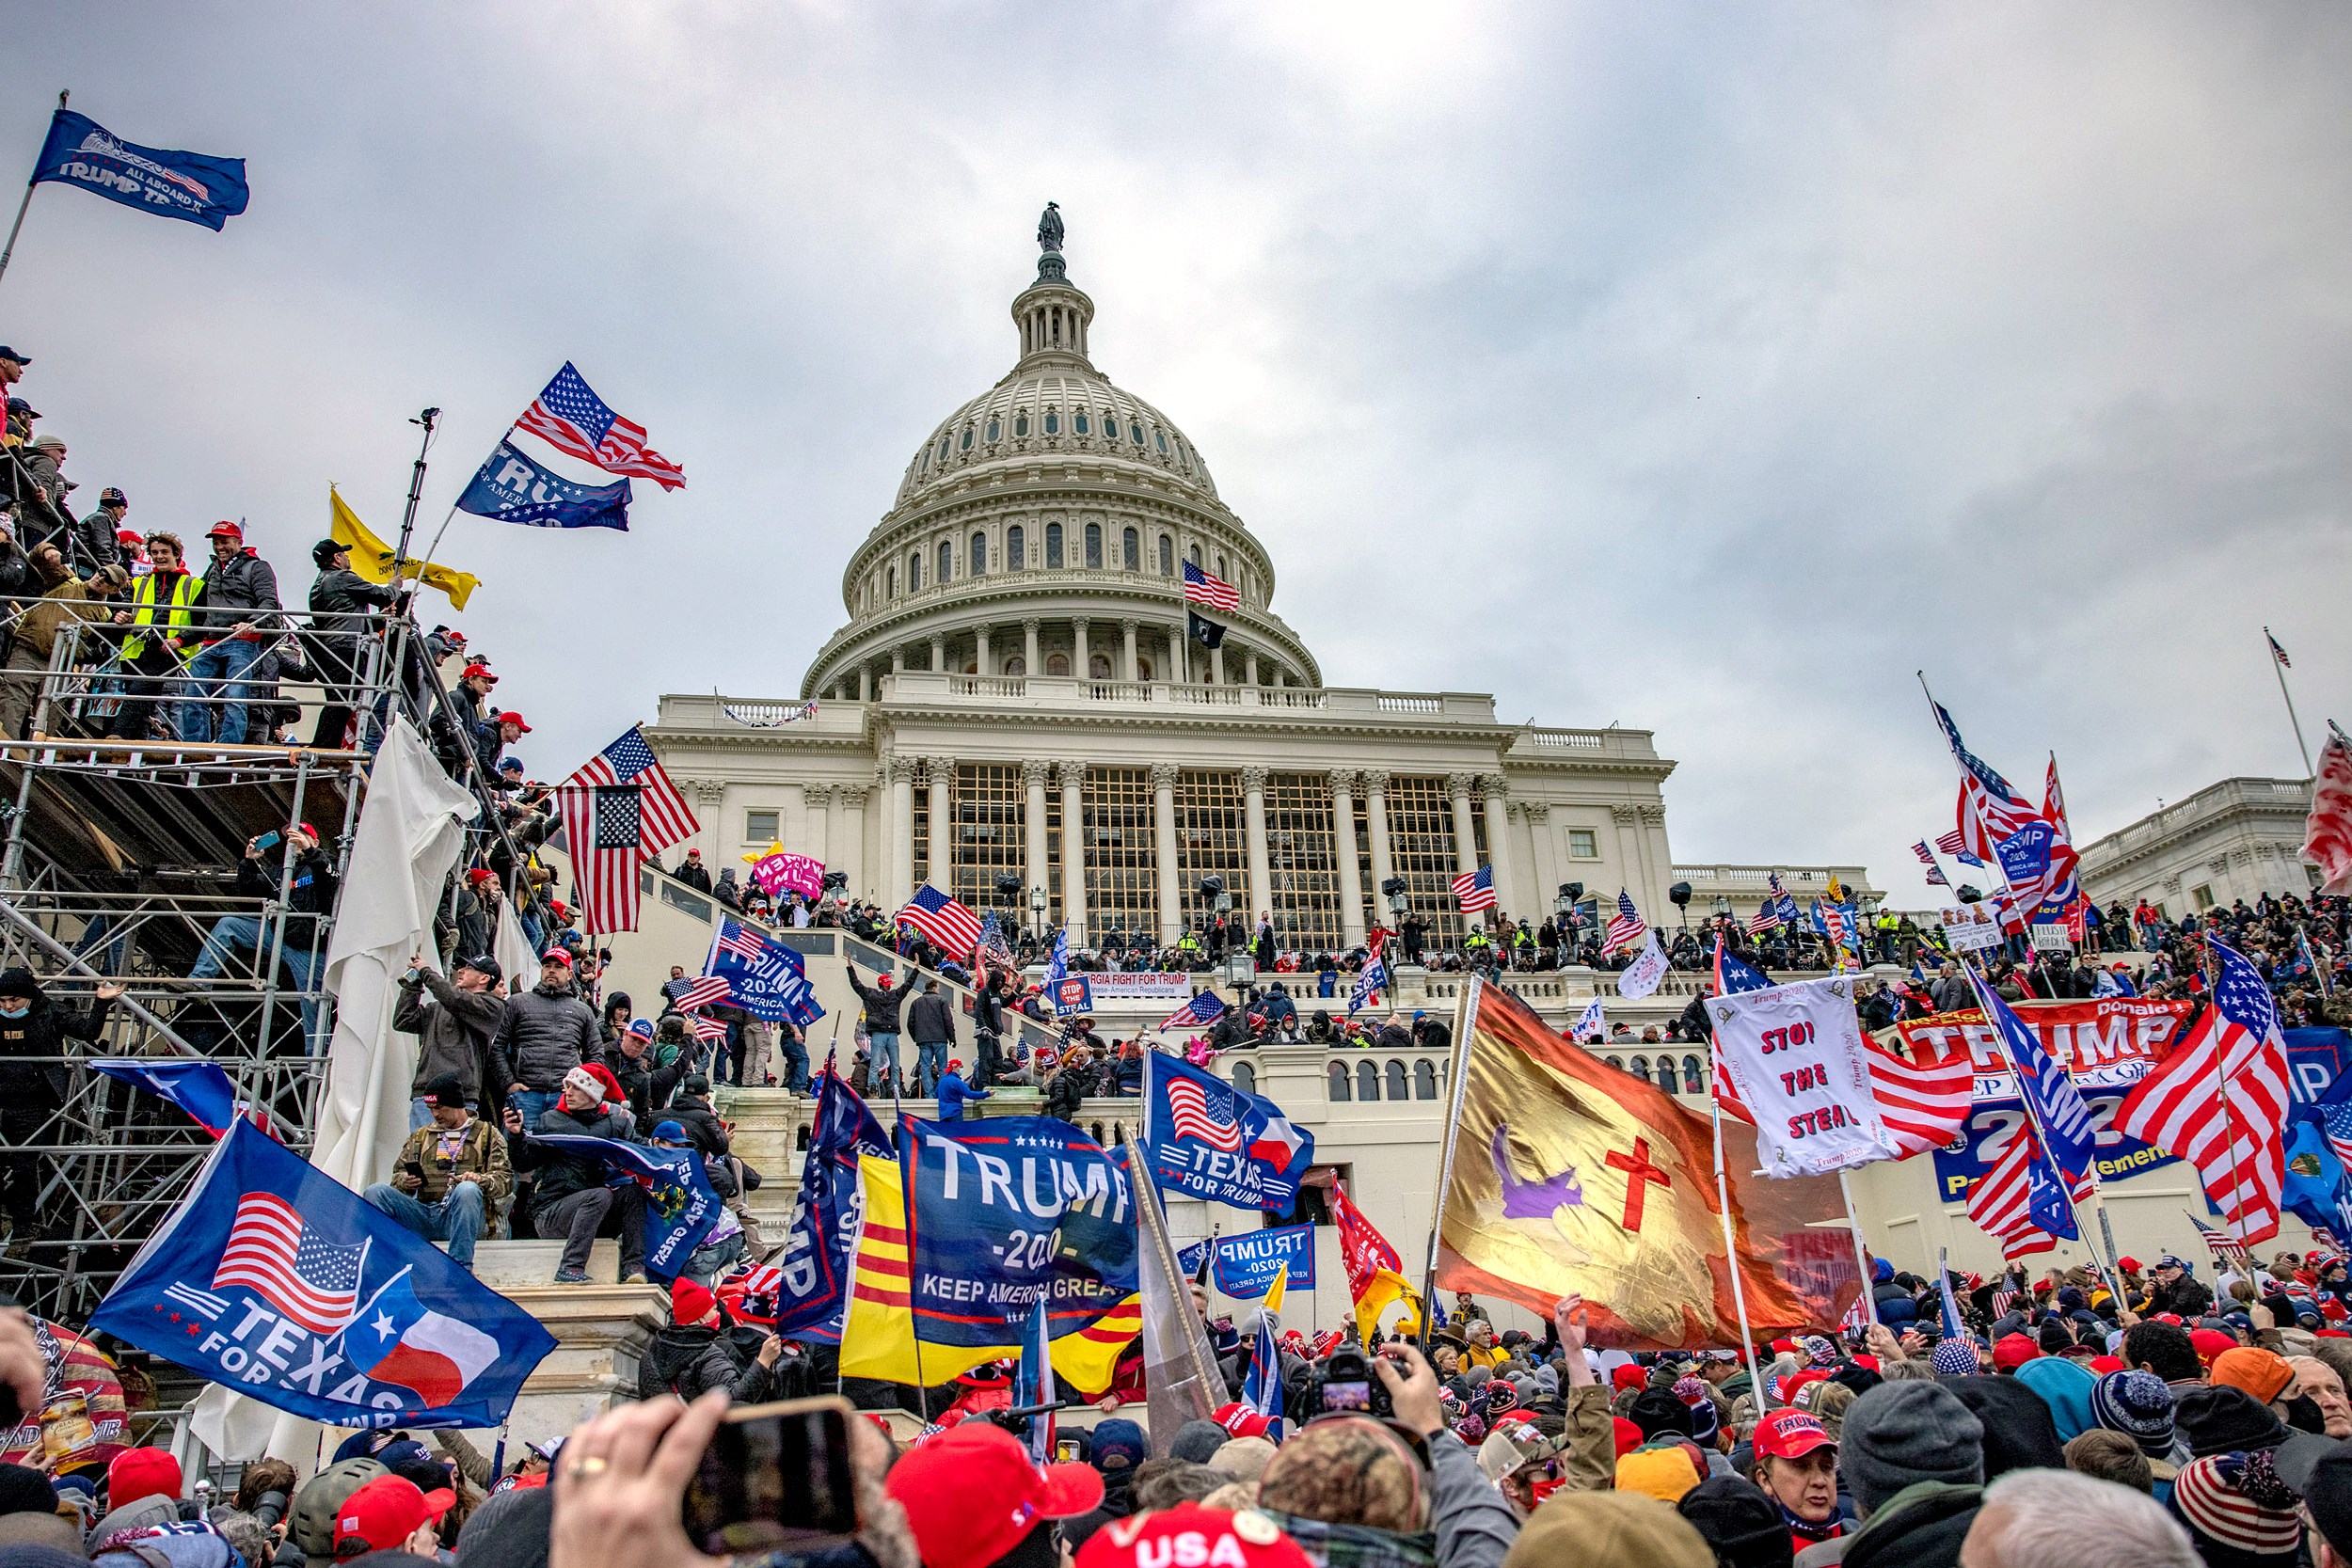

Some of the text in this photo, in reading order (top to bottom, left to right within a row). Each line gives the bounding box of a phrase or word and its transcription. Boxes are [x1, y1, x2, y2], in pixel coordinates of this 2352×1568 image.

[59, 162, 140, 194] TRUMP
[126, 167, 144, 181] ALL
[146, 173, 191, 206] ABOARD
[1061, 984, 1082, 995] STOP
[1112, 974, 1136, 985] FIGHT
[1139, 974, 1156, 985] FOR
[1158, 974, 1186, 985] TRUMP
[739, 993, 784, 1008] AMERICA
[1058, 1004, 1090, 1015] STEAL
[1752, 986, 1804, 1005] Trump 2020
[2098, 1001, 2169, 1016] Donald
[1908, 1015, 2177, 1066] TRUMP
[1845, 1035, 1863, 1090] Trump 2020
[1780, 1063, 1828, 1097] THE
[1974, 1079, 2001, 1096] EP
[1193, 1144, 1262, 1191] TEXAS
[1815, 1147, 1863, 1167] Trump 2020
[927, 1135, 1129, 1224] TRUMP
[1183, 1172, 1263, 1206] FOR TRUMP
[923, 1274, 984, 1303] KEEP
[199, 1331, 272, 1385] FOR
[1225, 1409, 1239, 1429] MAKE
[1232, 1412, 1248, 1431] GREAT
[1136, 1532, 1247, 1568] USA
